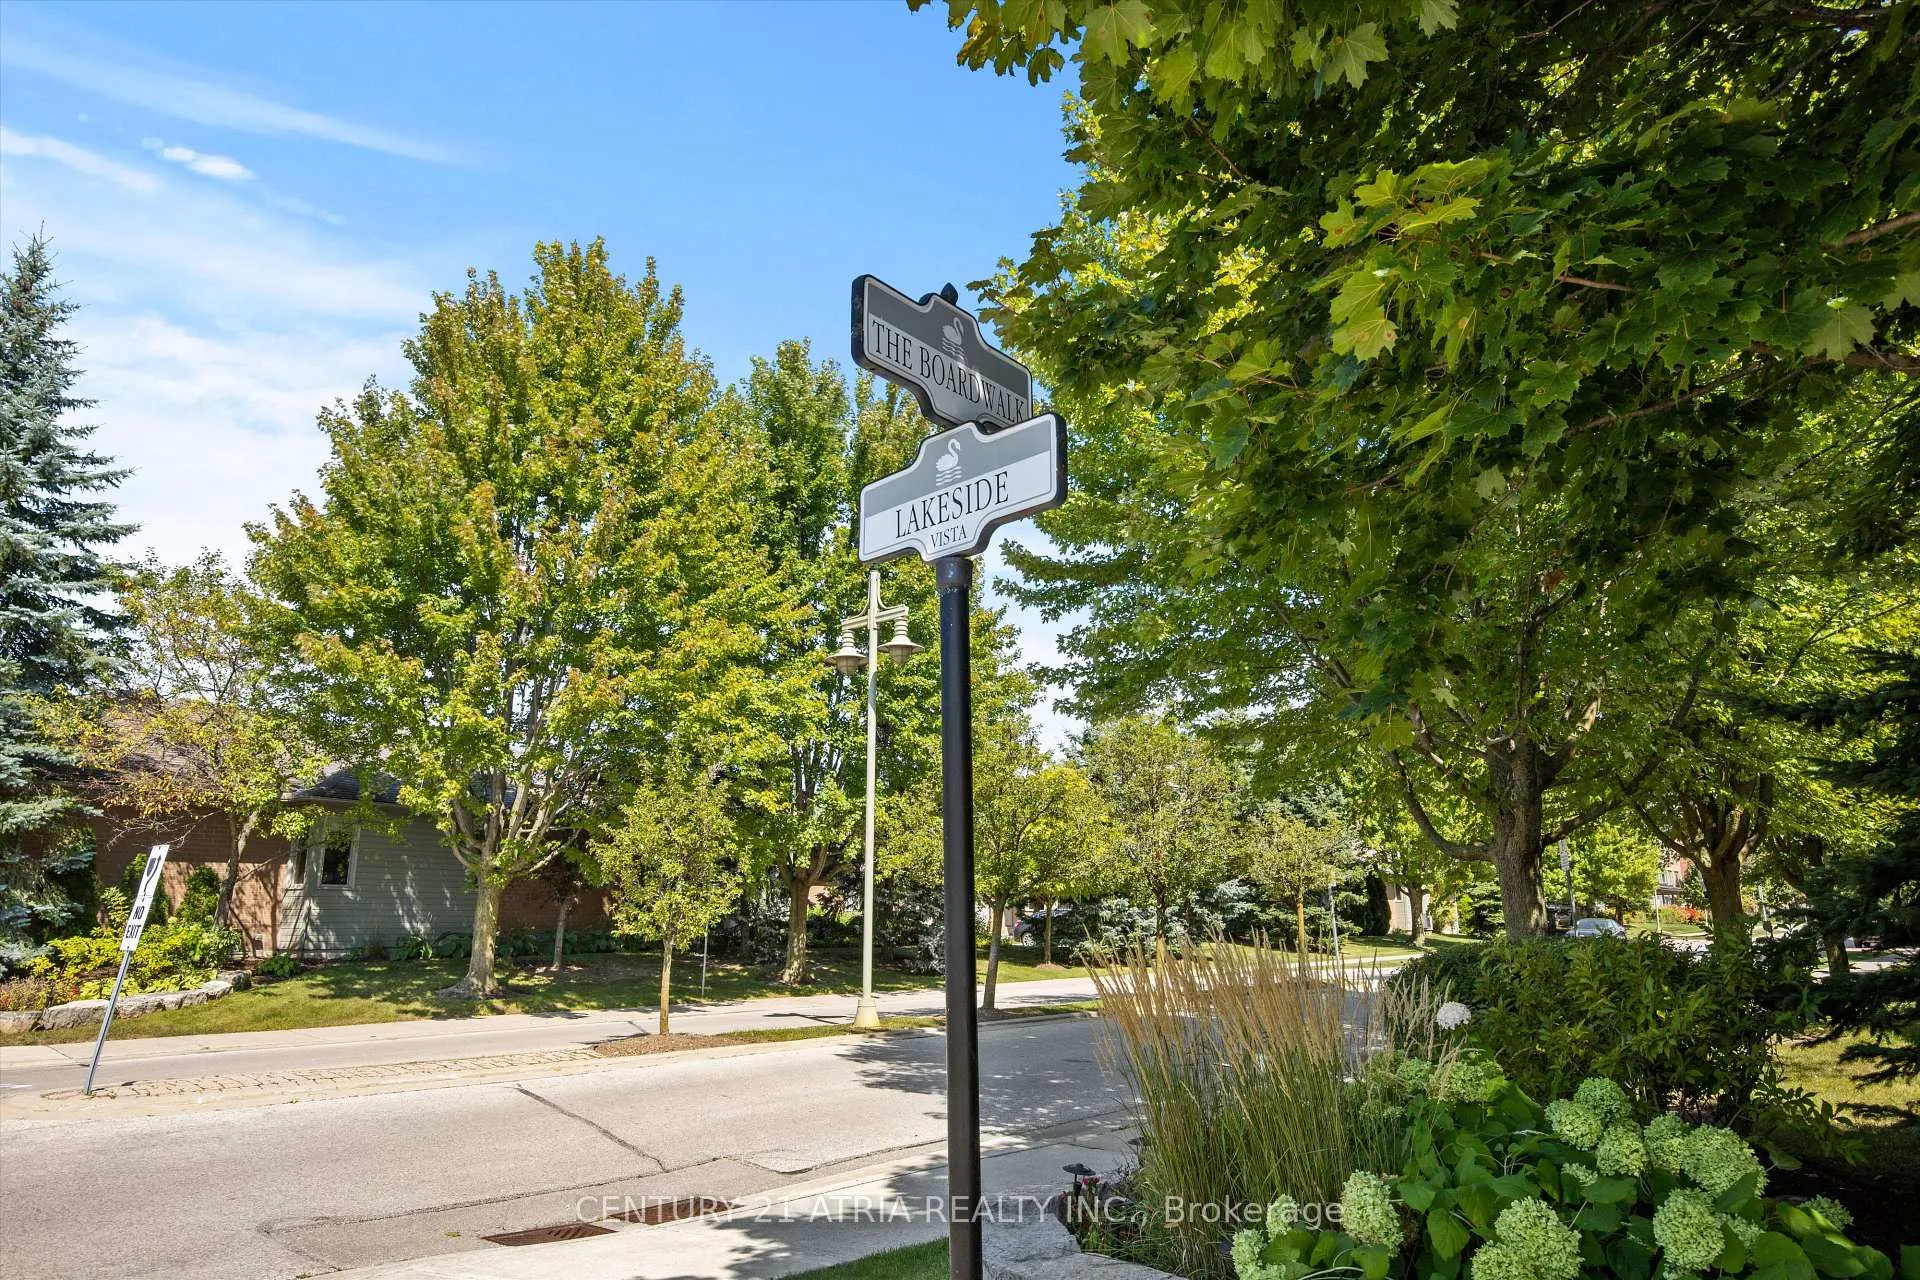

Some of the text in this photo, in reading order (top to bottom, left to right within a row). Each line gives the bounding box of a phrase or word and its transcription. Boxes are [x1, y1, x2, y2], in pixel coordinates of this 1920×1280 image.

[872, 319, 1026, 424] THE BOARDWALK
[895, 470, 1009, 539] LAKESIDE
[930, 524, 967, 549] VISTA
[133, 905, 145, 920] NO
[125, 924, 141, 939] EXIT
